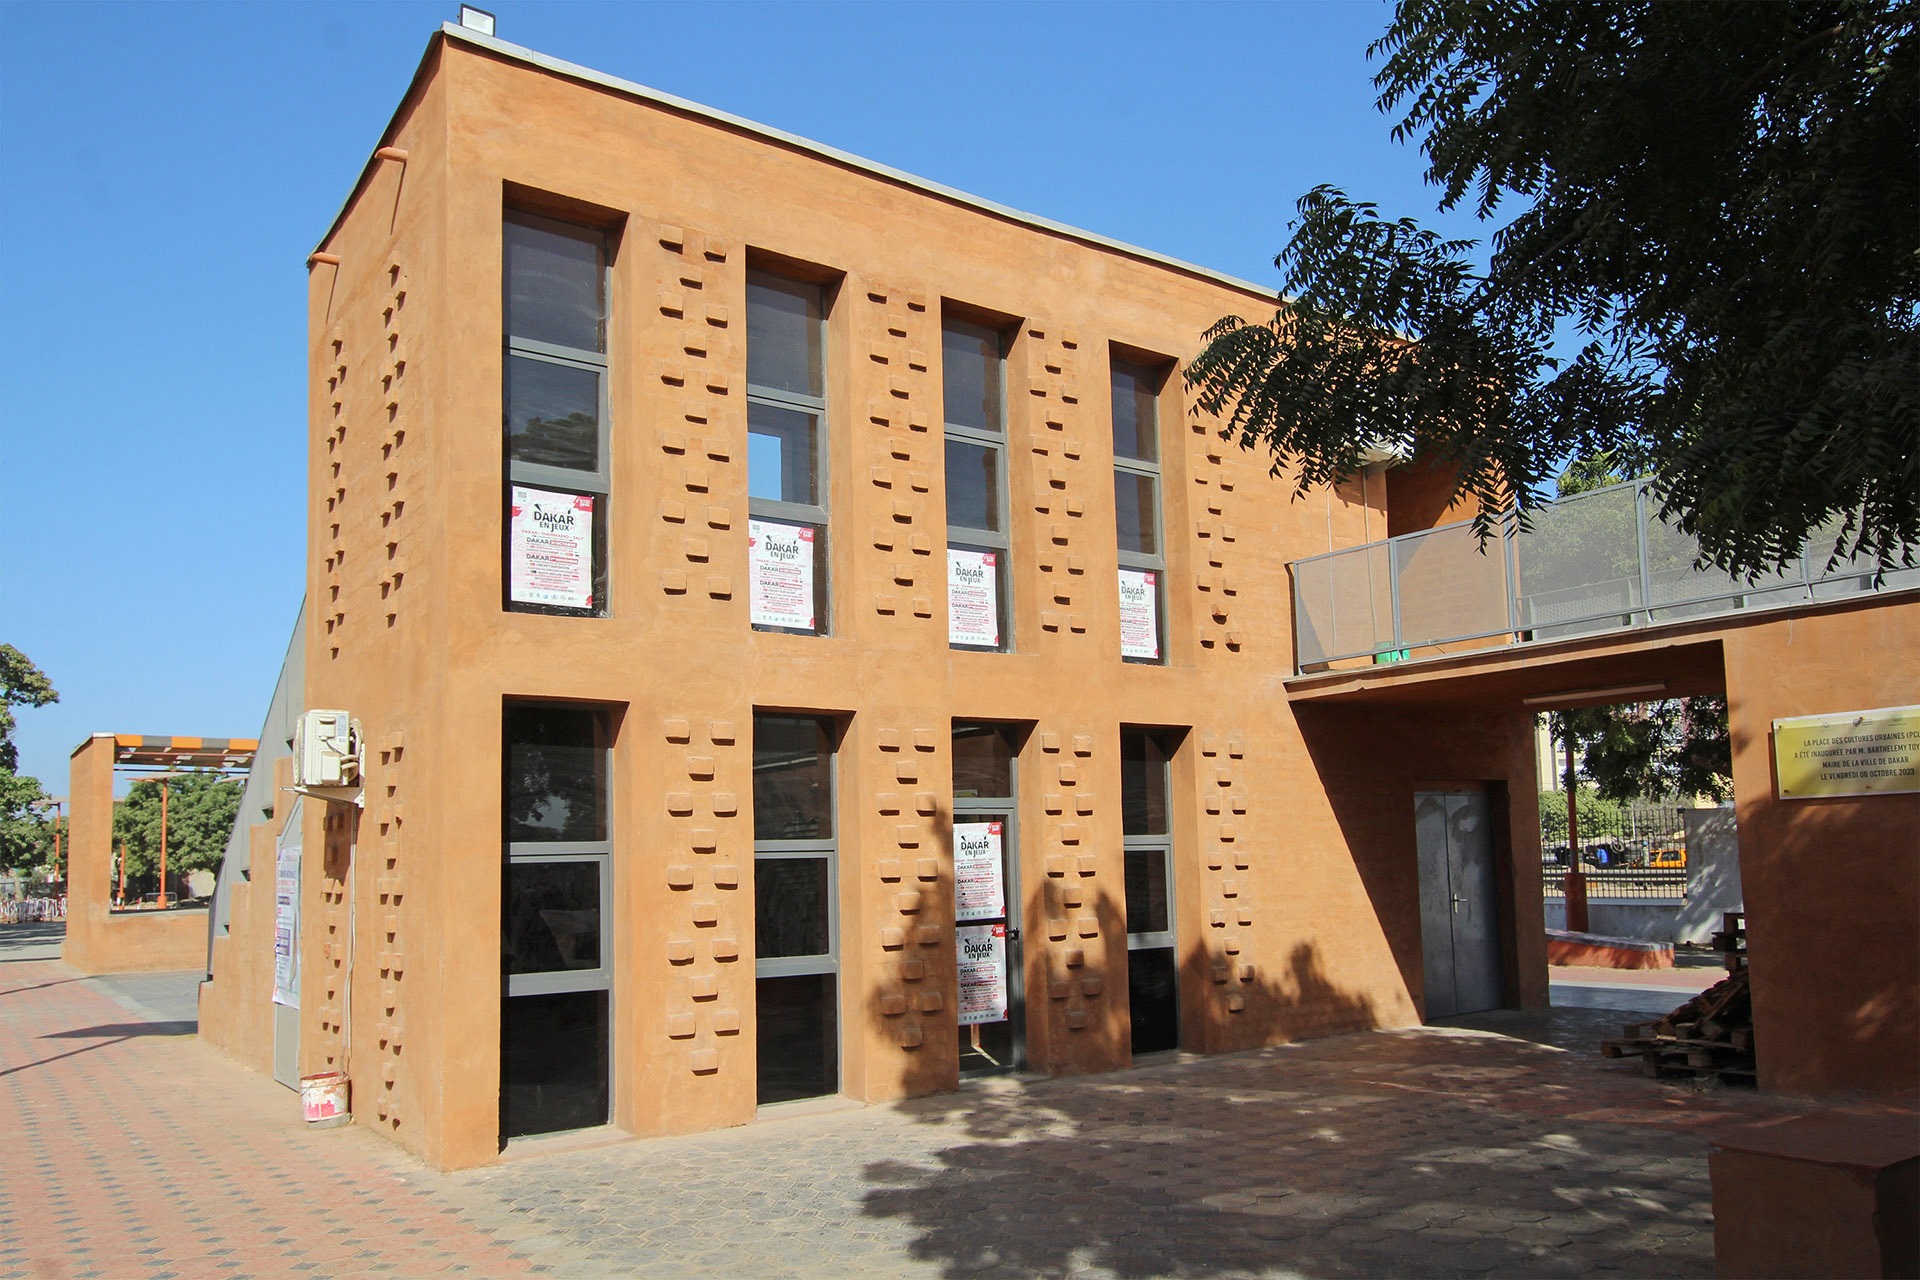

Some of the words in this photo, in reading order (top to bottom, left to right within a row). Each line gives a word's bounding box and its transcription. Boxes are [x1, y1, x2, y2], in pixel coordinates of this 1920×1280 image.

[534, 511, 574, 525] DAKAR
[540, 521, 549, 529] EN
[551, 522, 570, 532] JEUX
[765, 541, 799, 554] DAKAR
[526, 553, 550, 561] DAKAR
[780, 552, 795, 561] JEUX
[955, 567, 984, 578] DAKAR
[760, 579, 779, 587] DAKAR
[968, 576, 981, 585] JEUX
[1121, 586, 1145, 596] DAKAR
[1812, 738, 1830, 746] PLACE
[1831, 736, 1843, 745] DES
[1844, 734, 1874, 744] CULTURES
[1874, 732, 1906, 741] URBAINES
[1845, 747, 1857, 755] PAR
[1867, 744, 1907, 754] BARTHELEMY
[1822, 760, 1841, 768] MAIRE
[1842, 760, 1850, 768] DE
[1851, 759, 1860, 767] LA
[1860, 758, 1878, 766] VILLE
[1879, 757, 1887, 765] DE
[1888, 756, 1909, 764] DAKAR
[1820, 773, 1828, 781] LE
[1829, 771, 1859, 780] VENDREDI
[1860, 770, 1869, 778] 06
[1870, 768, 1897, 778] OCTOBRE
[1899, 768, 1915, 776] 2023
[961, 841, 989, 851] DAKAR
[973, 849, 987, 858] JEUX
[964, 943, 993, 954] DAKAR
[976, 952, 990, 961] JEUX
